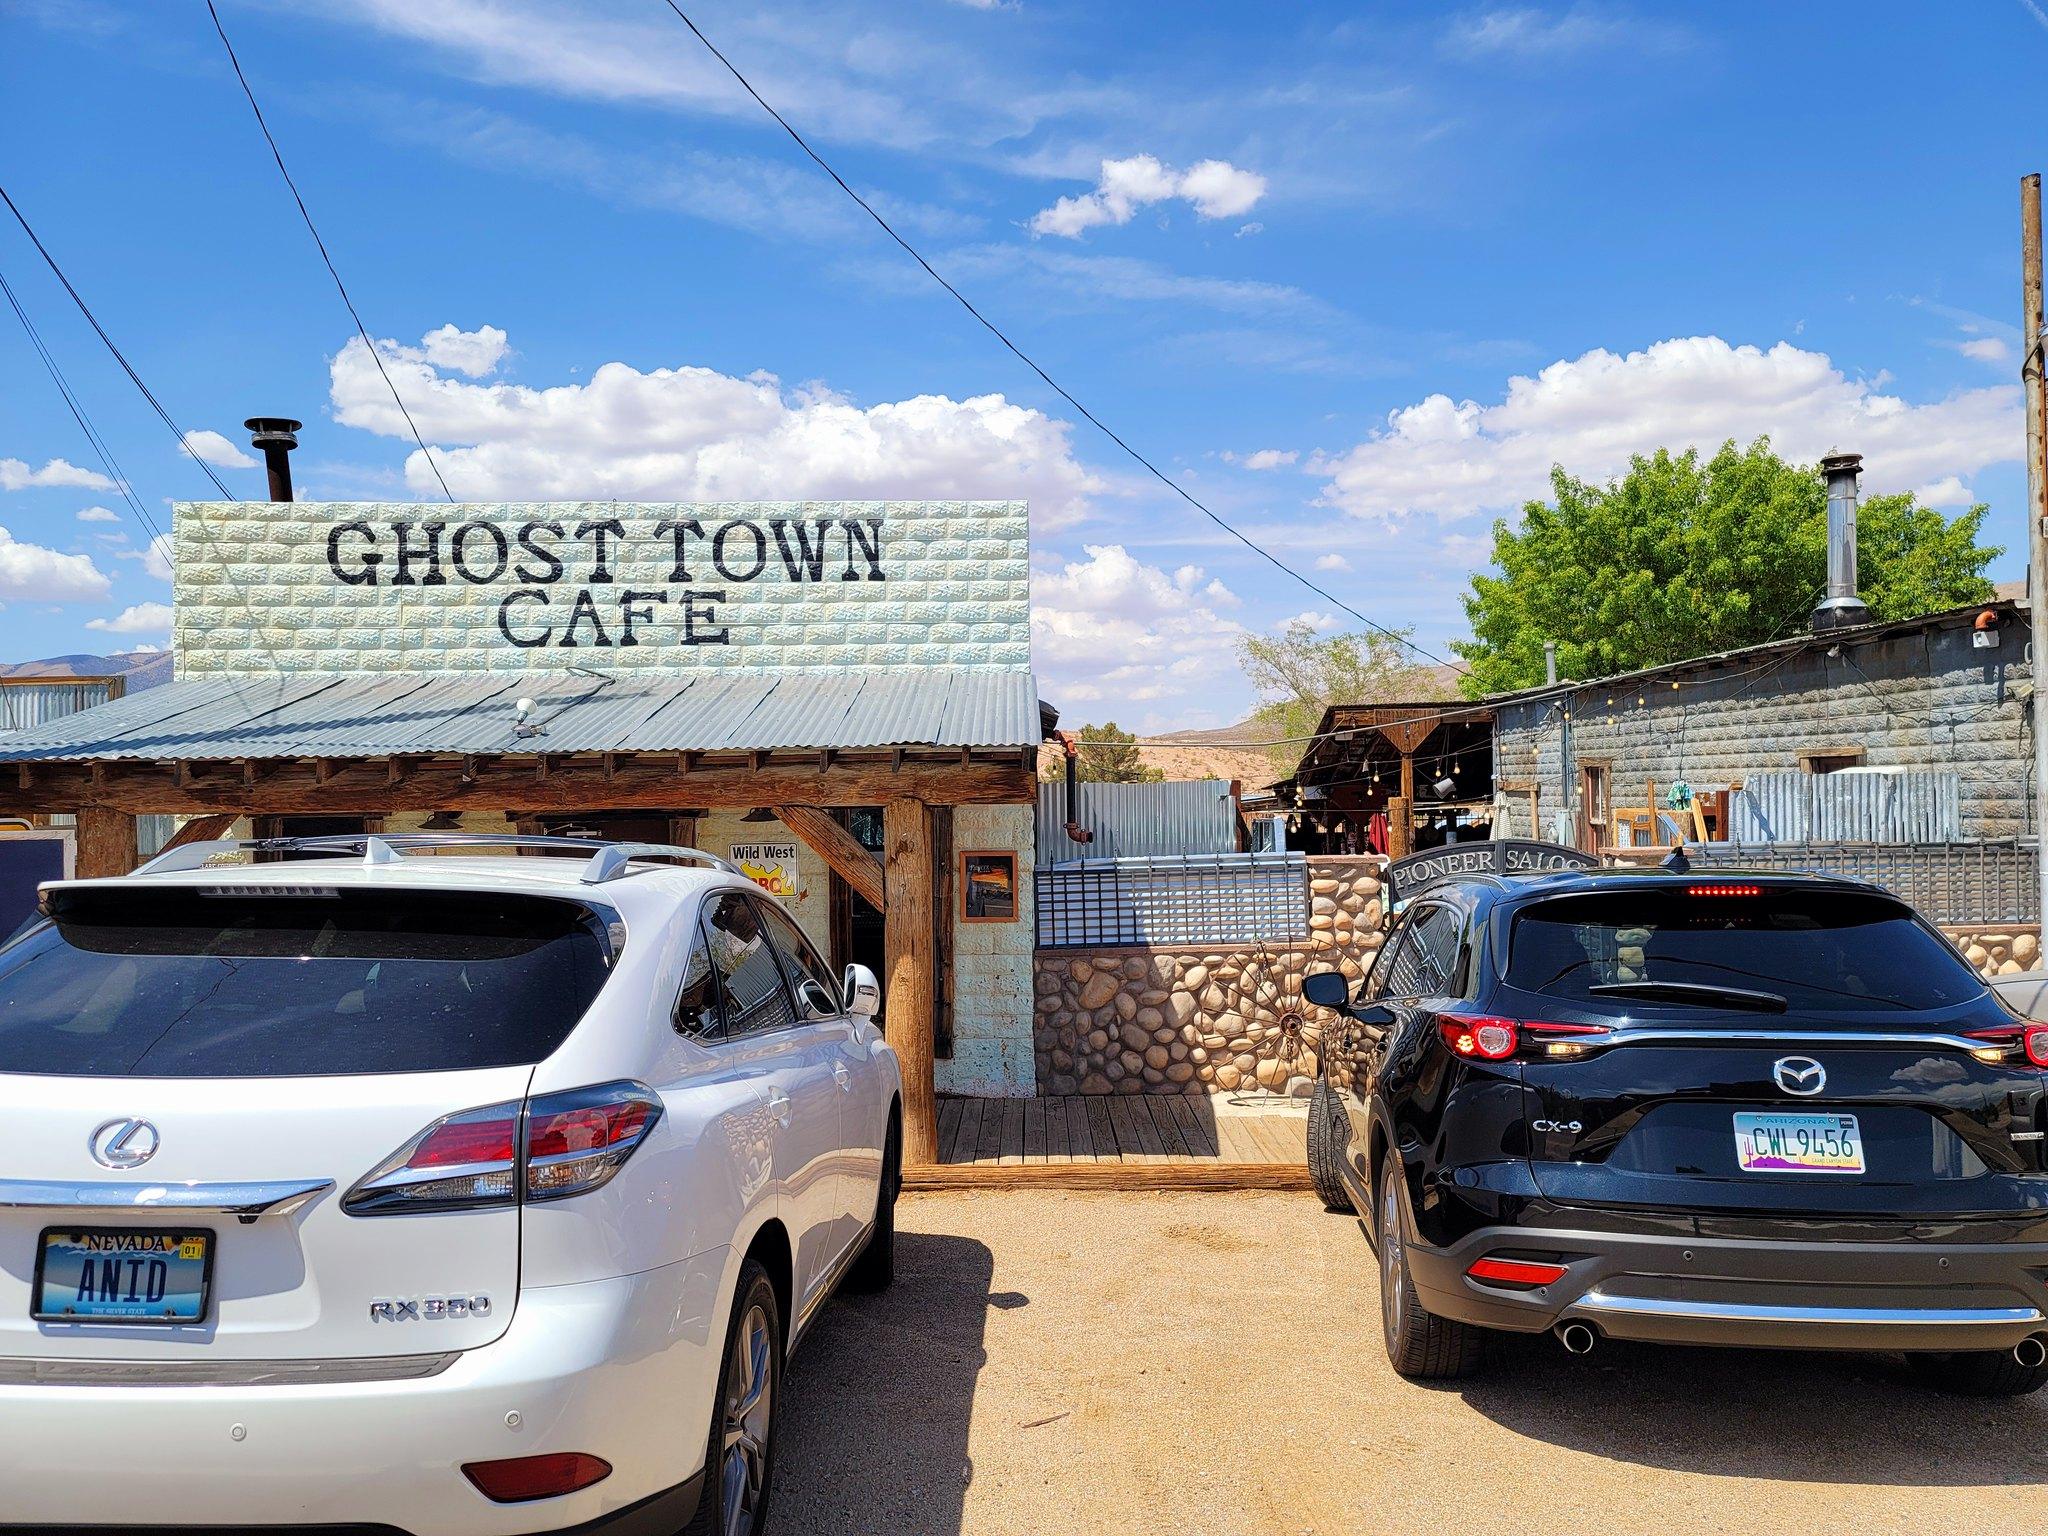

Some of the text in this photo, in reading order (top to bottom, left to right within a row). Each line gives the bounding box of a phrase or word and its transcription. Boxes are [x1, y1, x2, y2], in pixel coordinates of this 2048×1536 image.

[326, 518, 886, 586] GHOST TOWN
[497, 589, 730, 647] CAFE
[733, 846, 794, 859] Wild West
[1394, 850, 1588, 890] PIONEER SALO
[1532, 1119, 1582, 1134] CX-9
[1765, 1117, 1827, 1125] ARIZONA
[1752, 1127, 1854, 1157] CWL9456
[87, 1235, 167, 1251] NEVADA
[184, 1245, 196, 1255] 01
[77, 1259, 168, 1303] ANID
[370, 1296, 492, 1322] RX 350
